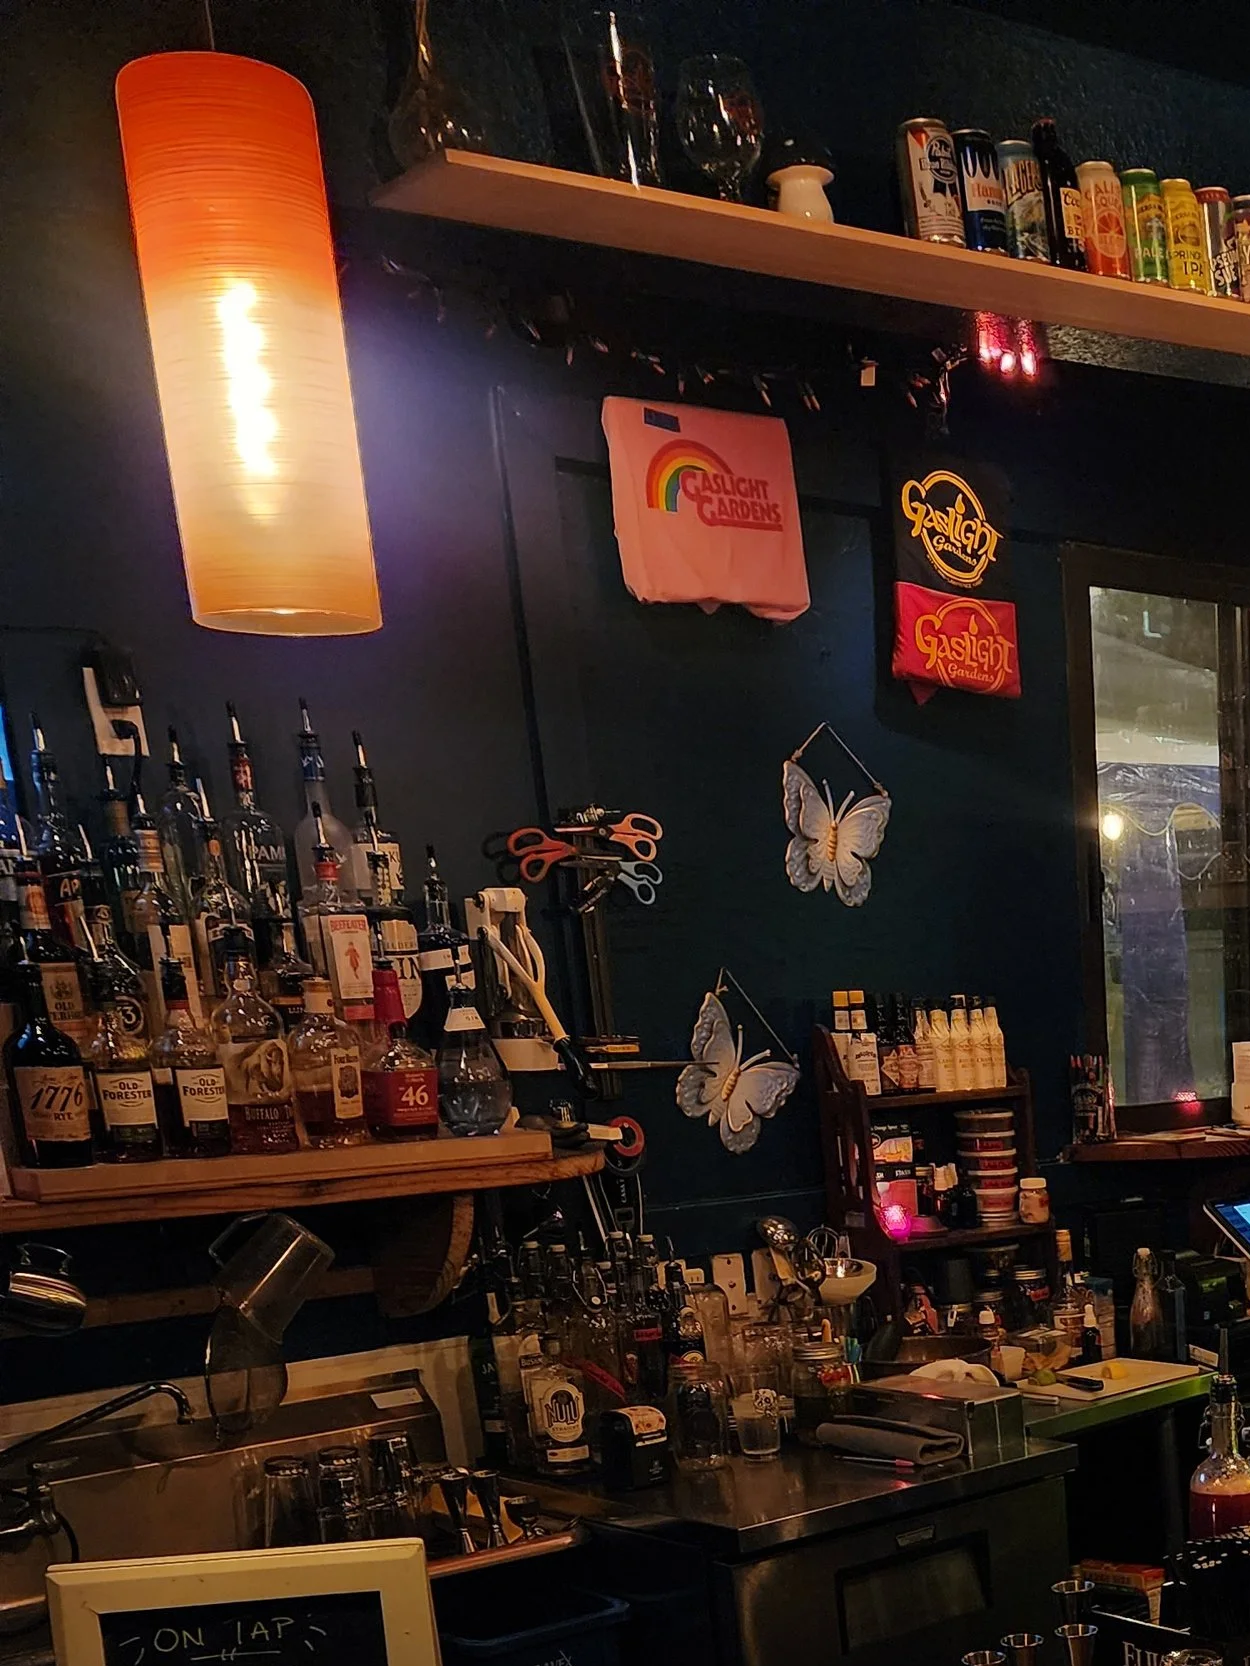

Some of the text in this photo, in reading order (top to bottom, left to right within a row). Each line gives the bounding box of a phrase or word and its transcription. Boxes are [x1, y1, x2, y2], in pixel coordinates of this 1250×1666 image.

[681, 471, 768, 502] GASLIGHT
[697, 495, 782, 530] GARDENS
[932, 535, 978, 567] Gardens
[947, 663, 995, 684] Gardens
[118, 1081, 138, 1091] OLD
[183, 1085, 225, 1096] FORESTE
[198, 1078, 217, 1087] OLD
[31, 1083, 84, 1111] 1776
[103, 1090, 152, 1100] FORESTER
[401, 1084, 429, 1107] 46
[54, 1113, 74, 1121] RYE
[245, 1106, 279, 1121] BUFFALO
[545, 1395, 580, 1428] NULU
[154, 1616, 295, 1653] ON TAP
